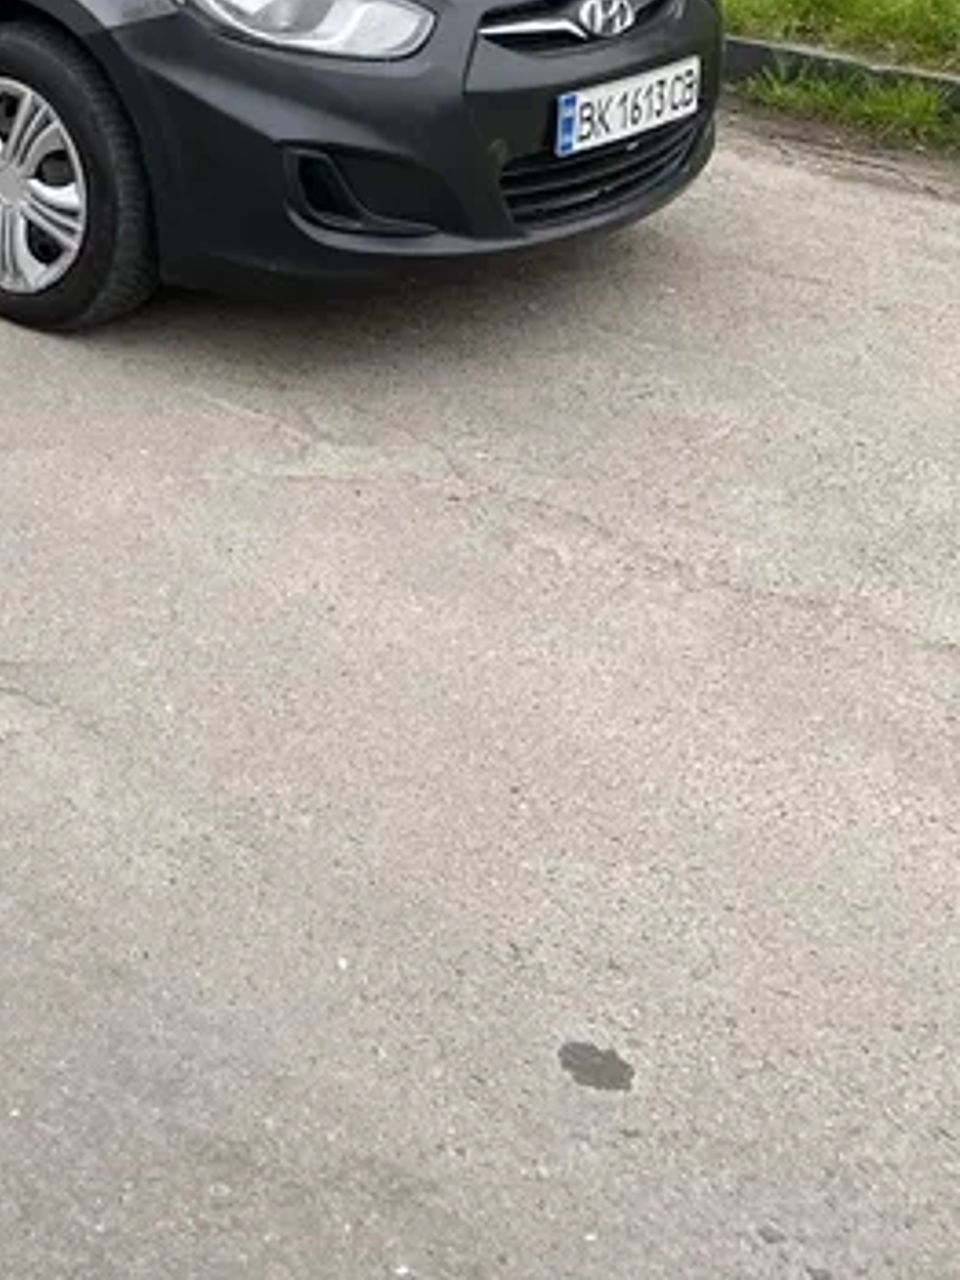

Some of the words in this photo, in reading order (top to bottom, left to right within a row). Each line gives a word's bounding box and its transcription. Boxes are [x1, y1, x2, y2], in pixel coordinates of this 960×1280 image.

[578, 96, 613, 141] BK
[616, 80, 667, 129] 1613
[671, 68, 696, 111] CB
